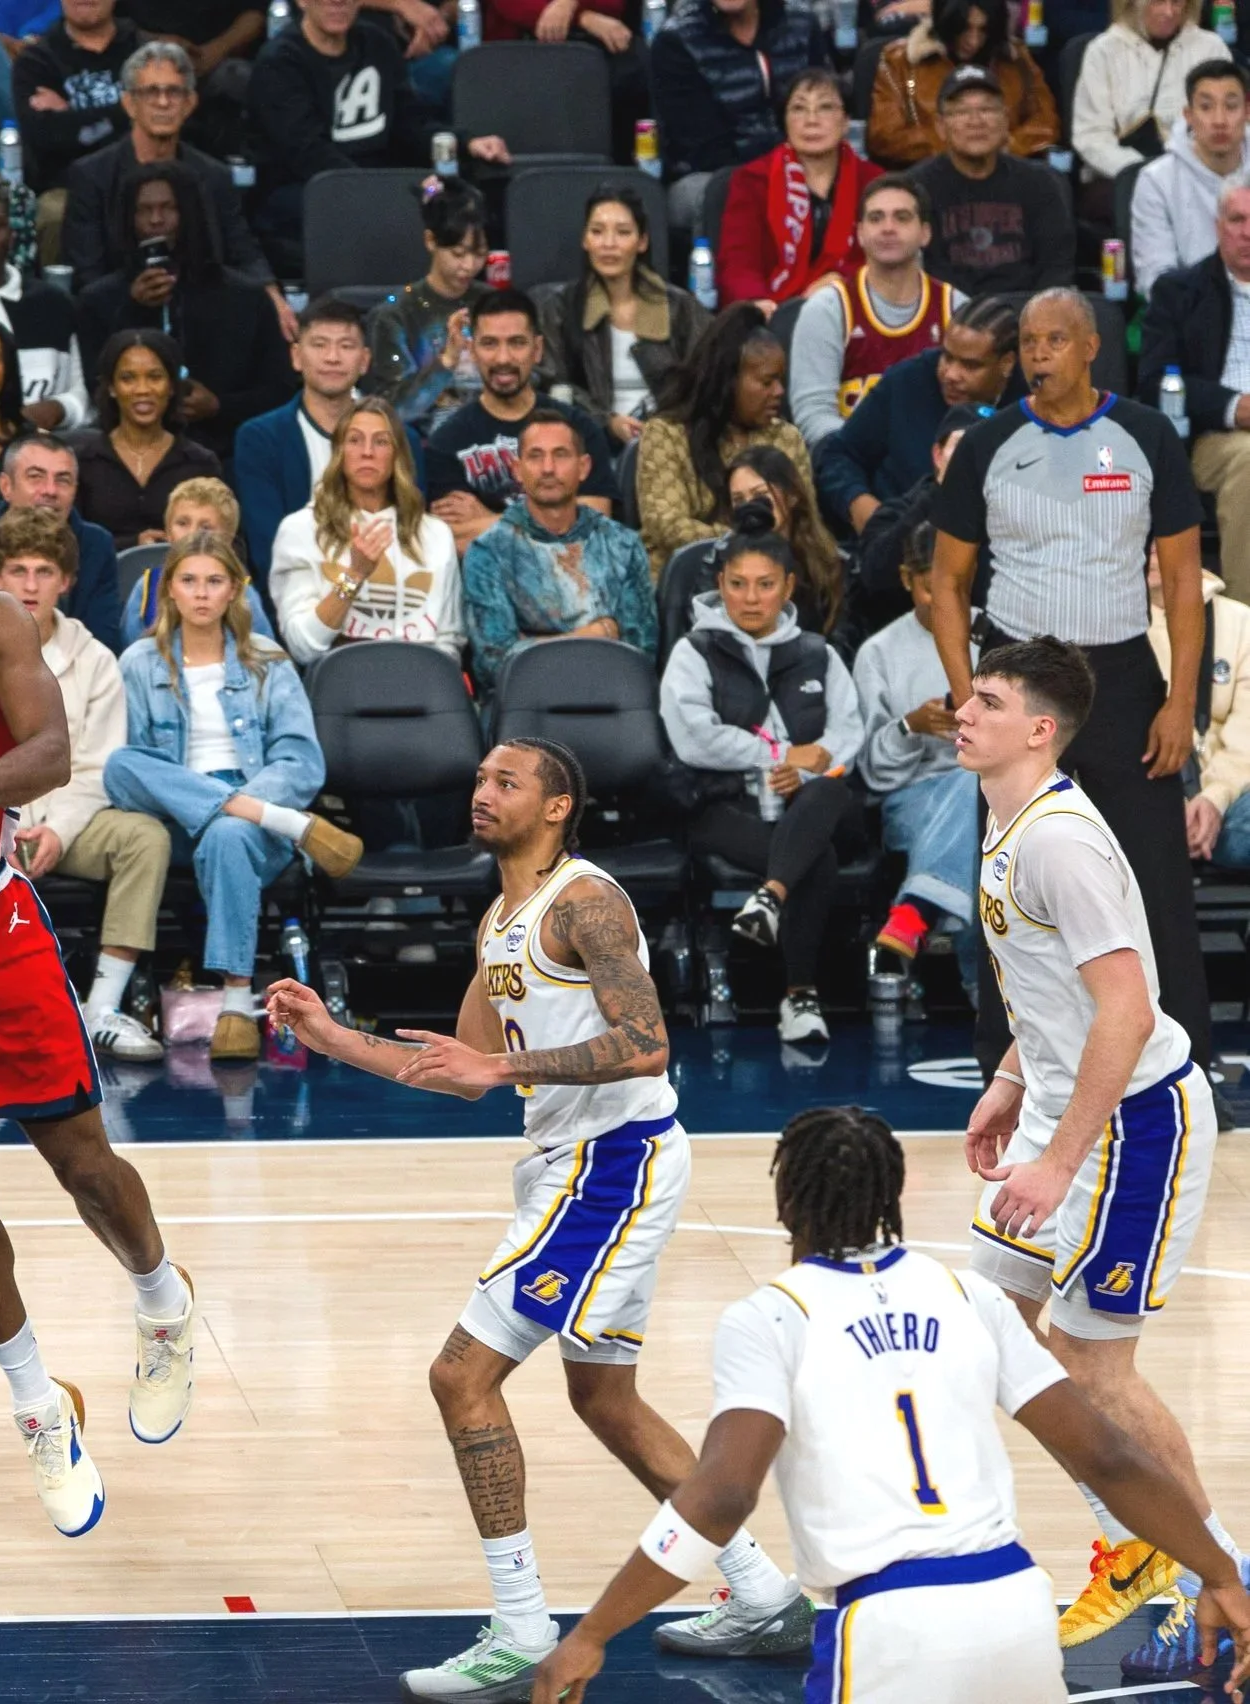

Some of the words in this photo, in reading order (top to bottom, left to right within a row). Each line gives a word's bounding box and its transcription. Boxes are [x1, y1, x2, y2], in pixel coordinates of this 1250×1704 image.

[1084, 477, 1130, 490] Emirates
[487, 962, 527, 1002] KERS
[844, 1312, 940, 1360] THIERO
[895, 1389, 948, 1515] 1
